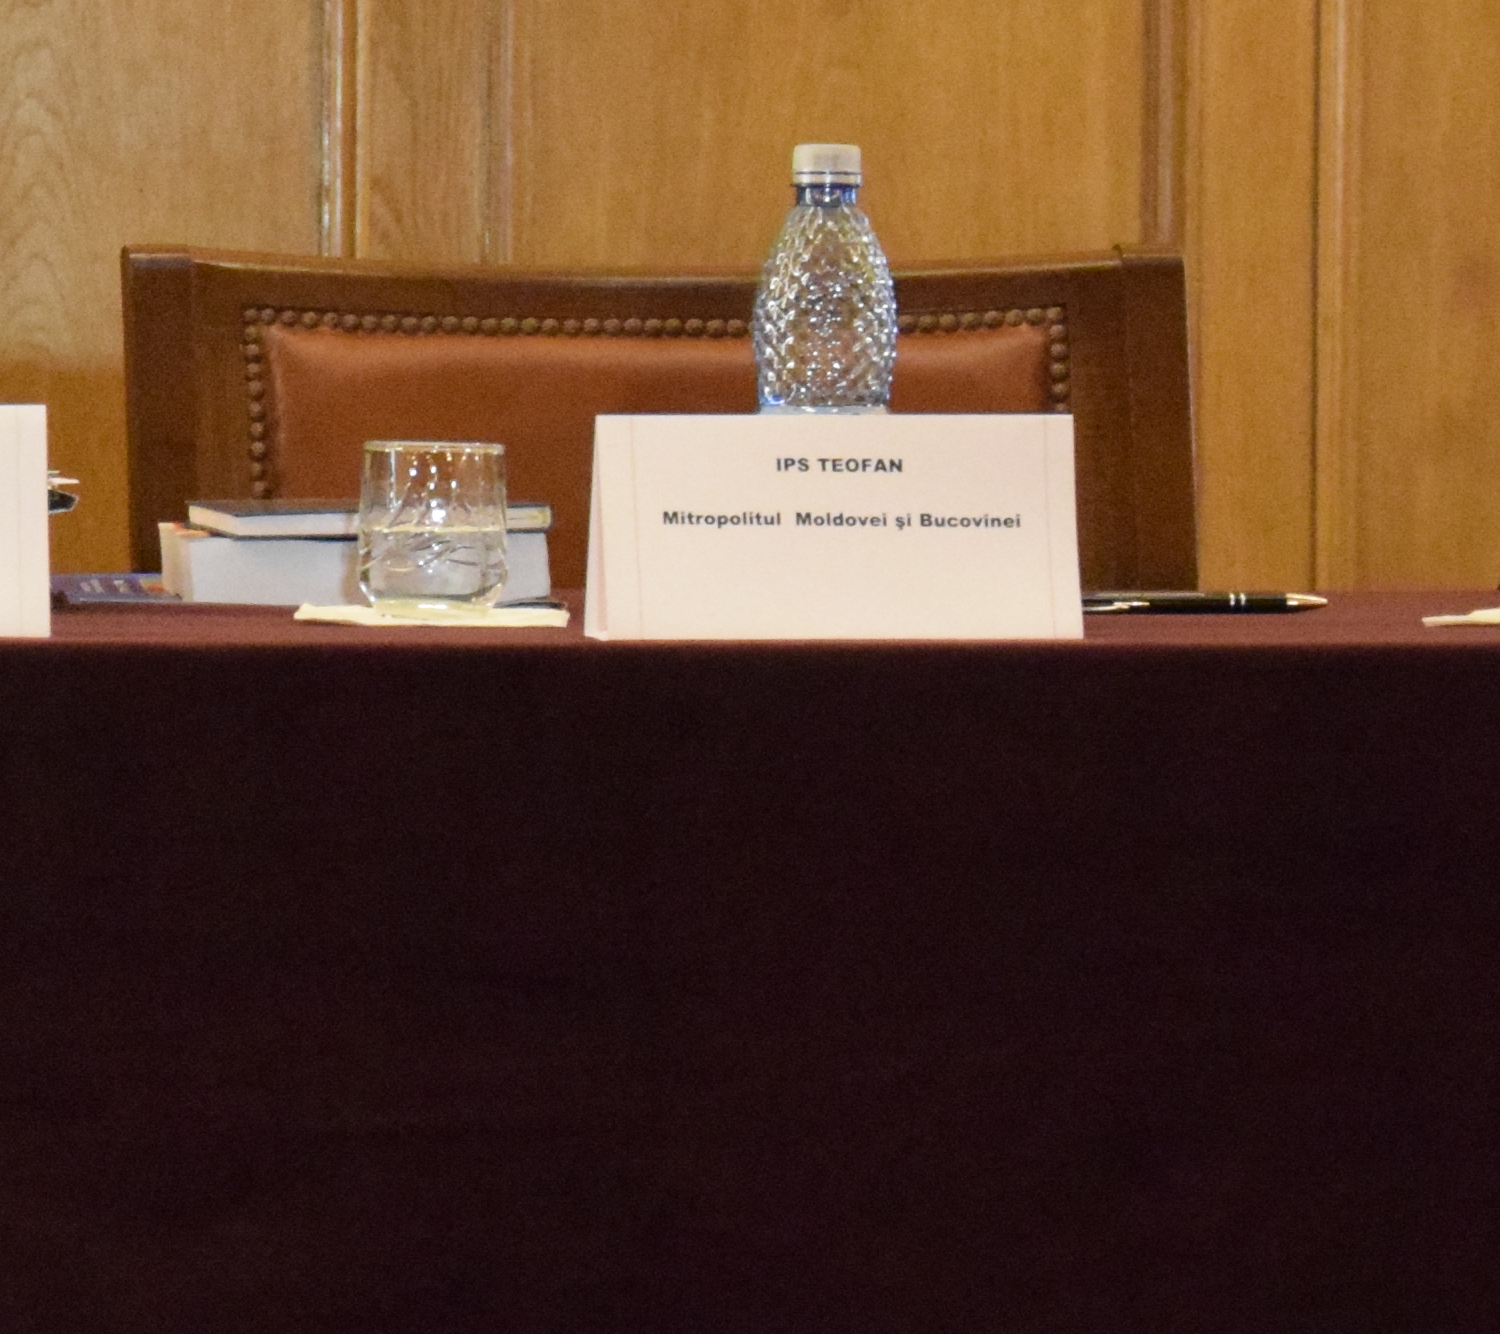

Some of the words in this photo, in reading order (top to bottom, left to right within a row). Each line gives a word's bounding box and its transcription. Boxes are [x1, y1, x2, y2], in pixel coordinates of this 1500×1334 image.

[775, 456, 812, 474] IPS
[815, 456, 904, 474] TEOFAN
[661, 509, 783, 531] Mitropolitul
[794, 510, 889, 529] Moldovei
[918, 511, 1022, 530] Bucovinei
